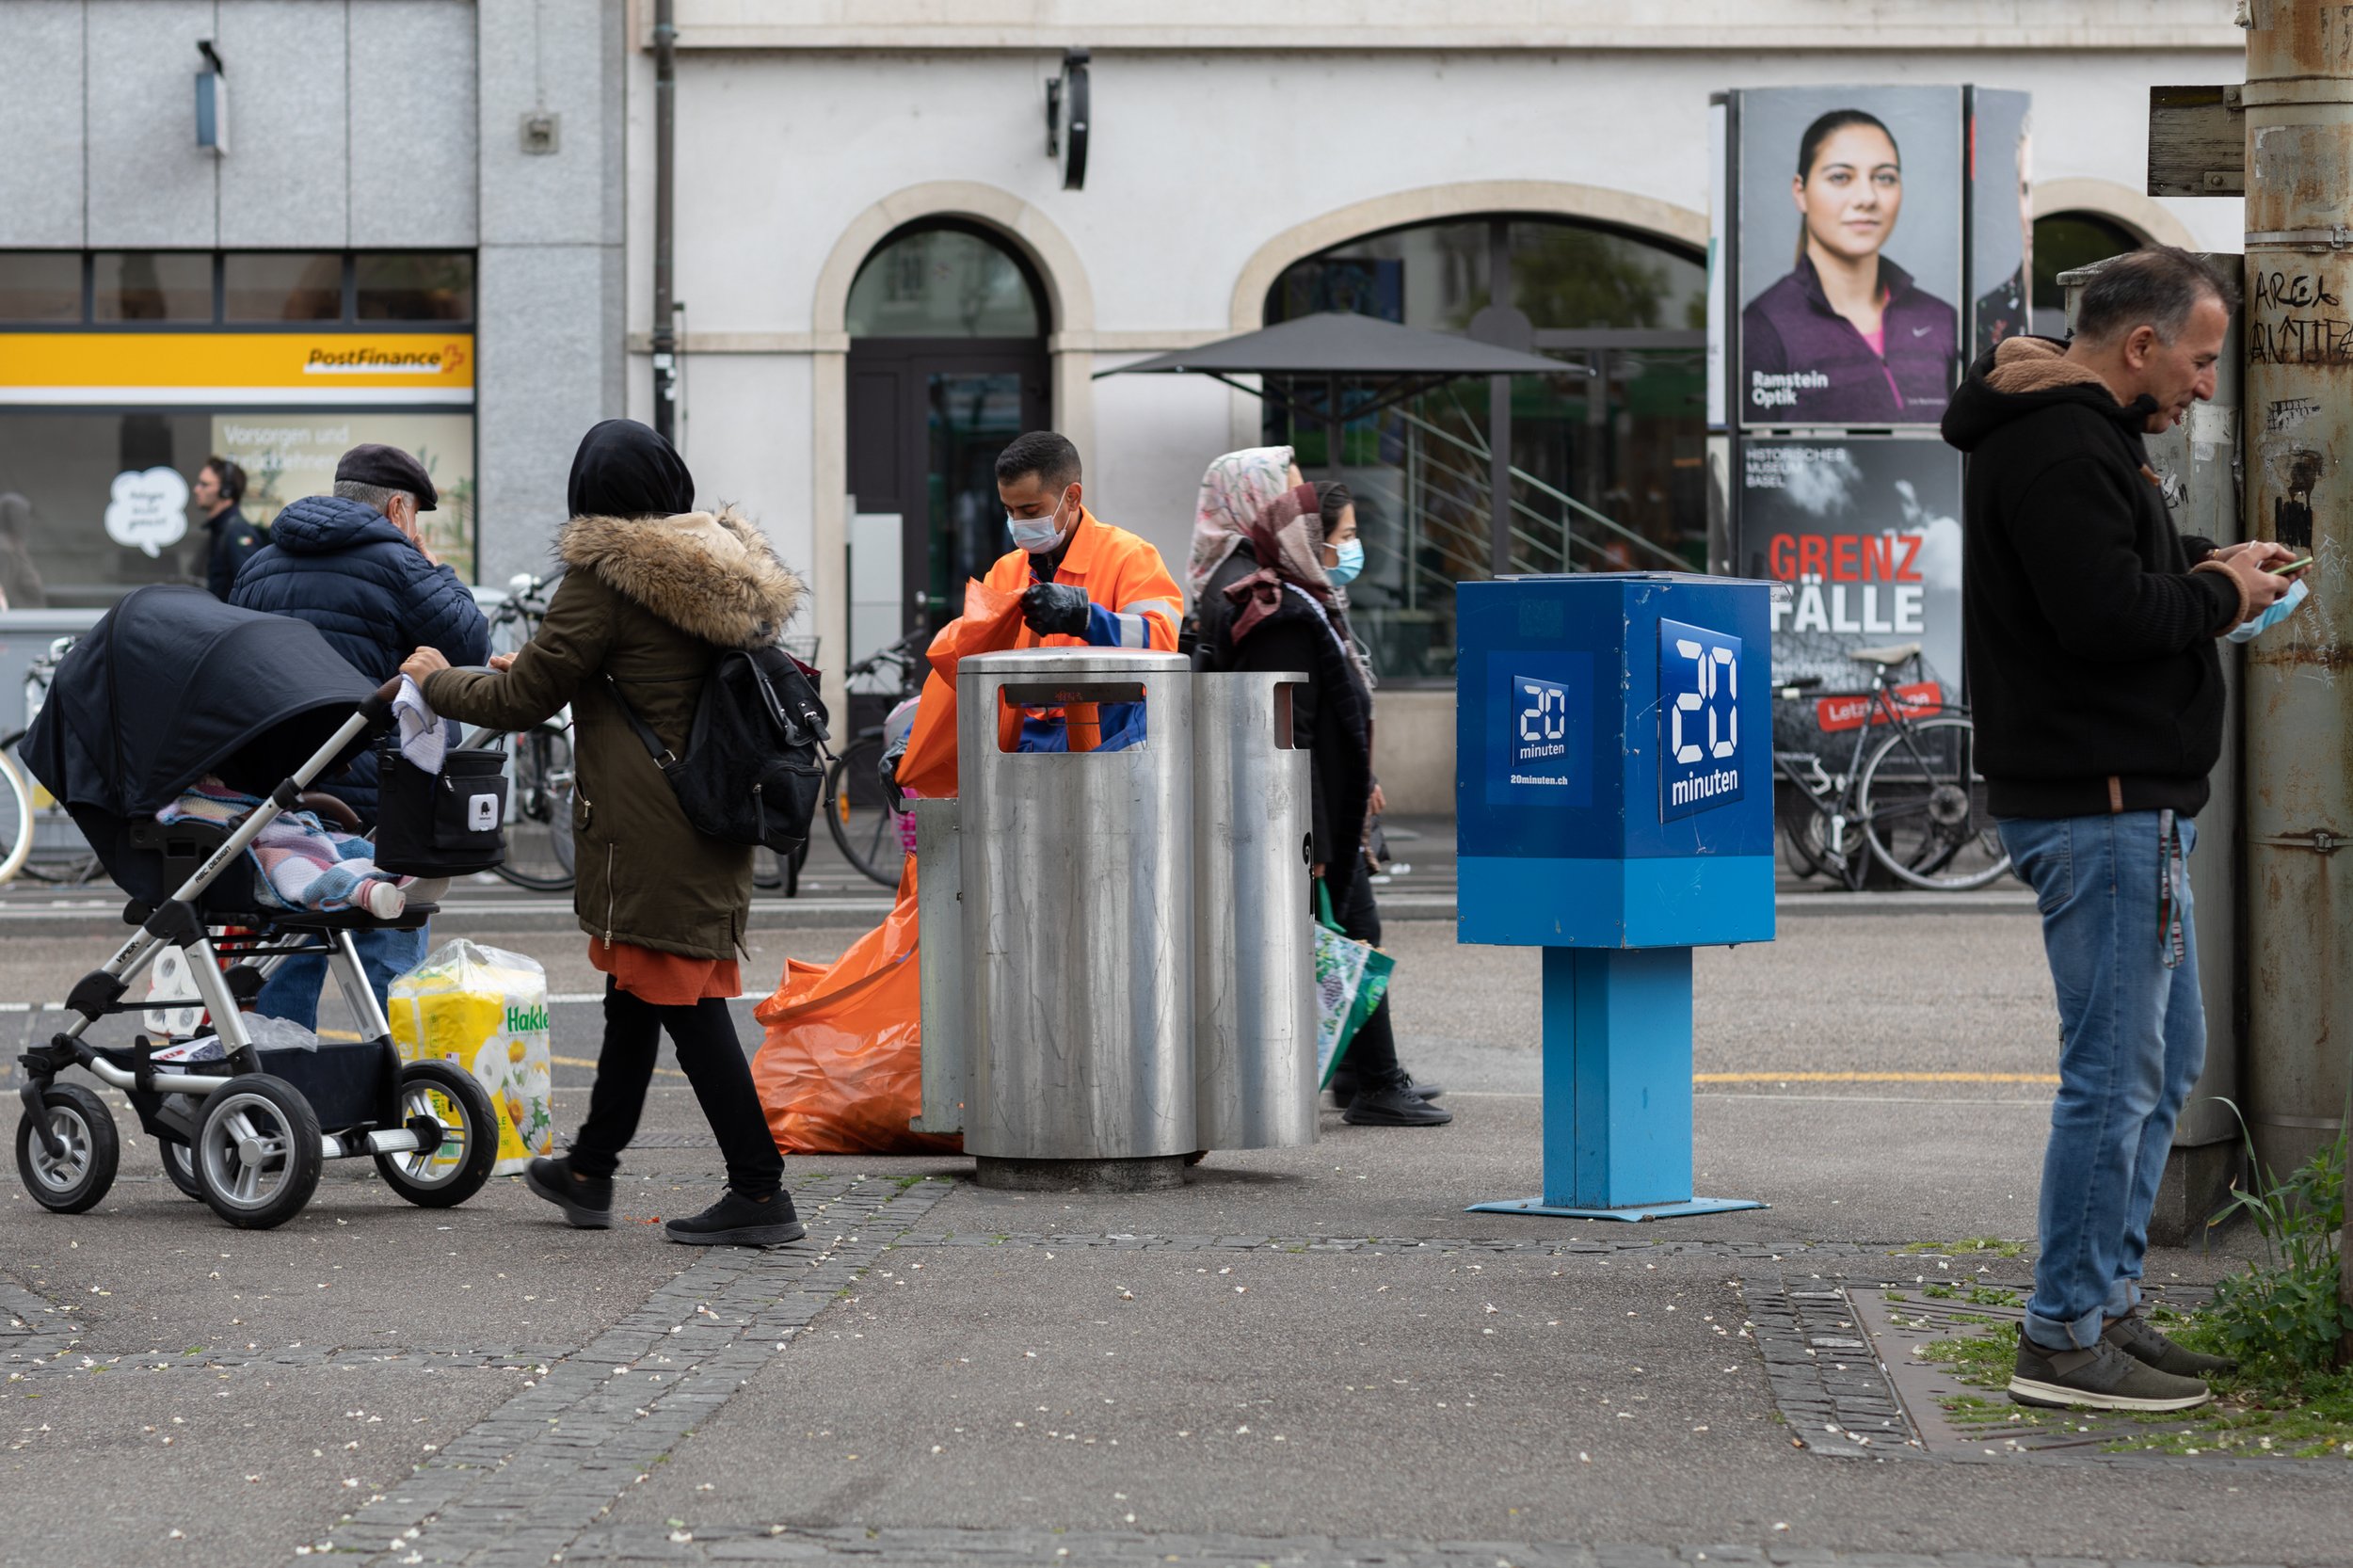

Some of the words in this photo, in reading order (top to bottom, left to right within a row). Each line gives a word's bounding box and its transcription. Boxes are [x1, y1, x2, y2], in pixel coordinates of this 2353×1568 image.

[308, 347, 441, 365] PostFinance
[1752, 370, 1830, 388] Ramstein
[1752, 388, 1798, 409] Optik
[223, 424, 312, 449] Vorsorgen
[315, 423, 350, 445] und
[1745, 461, 1804, 474] MUSEUM
[1745, 474, 1786, 488] BASEL
[1769, 533, 1924, 583] GRENZ
[1770, 573, 1925, 633] FÄLLE
[1520, 684, 1565, 742] 20
[1672, 639, 1737, 764] 20
[1520, 744, 1565, 760] minuten
[1510, 775, 1569, 786] 20minuten.ch
[1672, 768, 1738, 807] minuten
[194, 867, 209, 884] ABC
[208, 845, 232, 870] DESIGN
